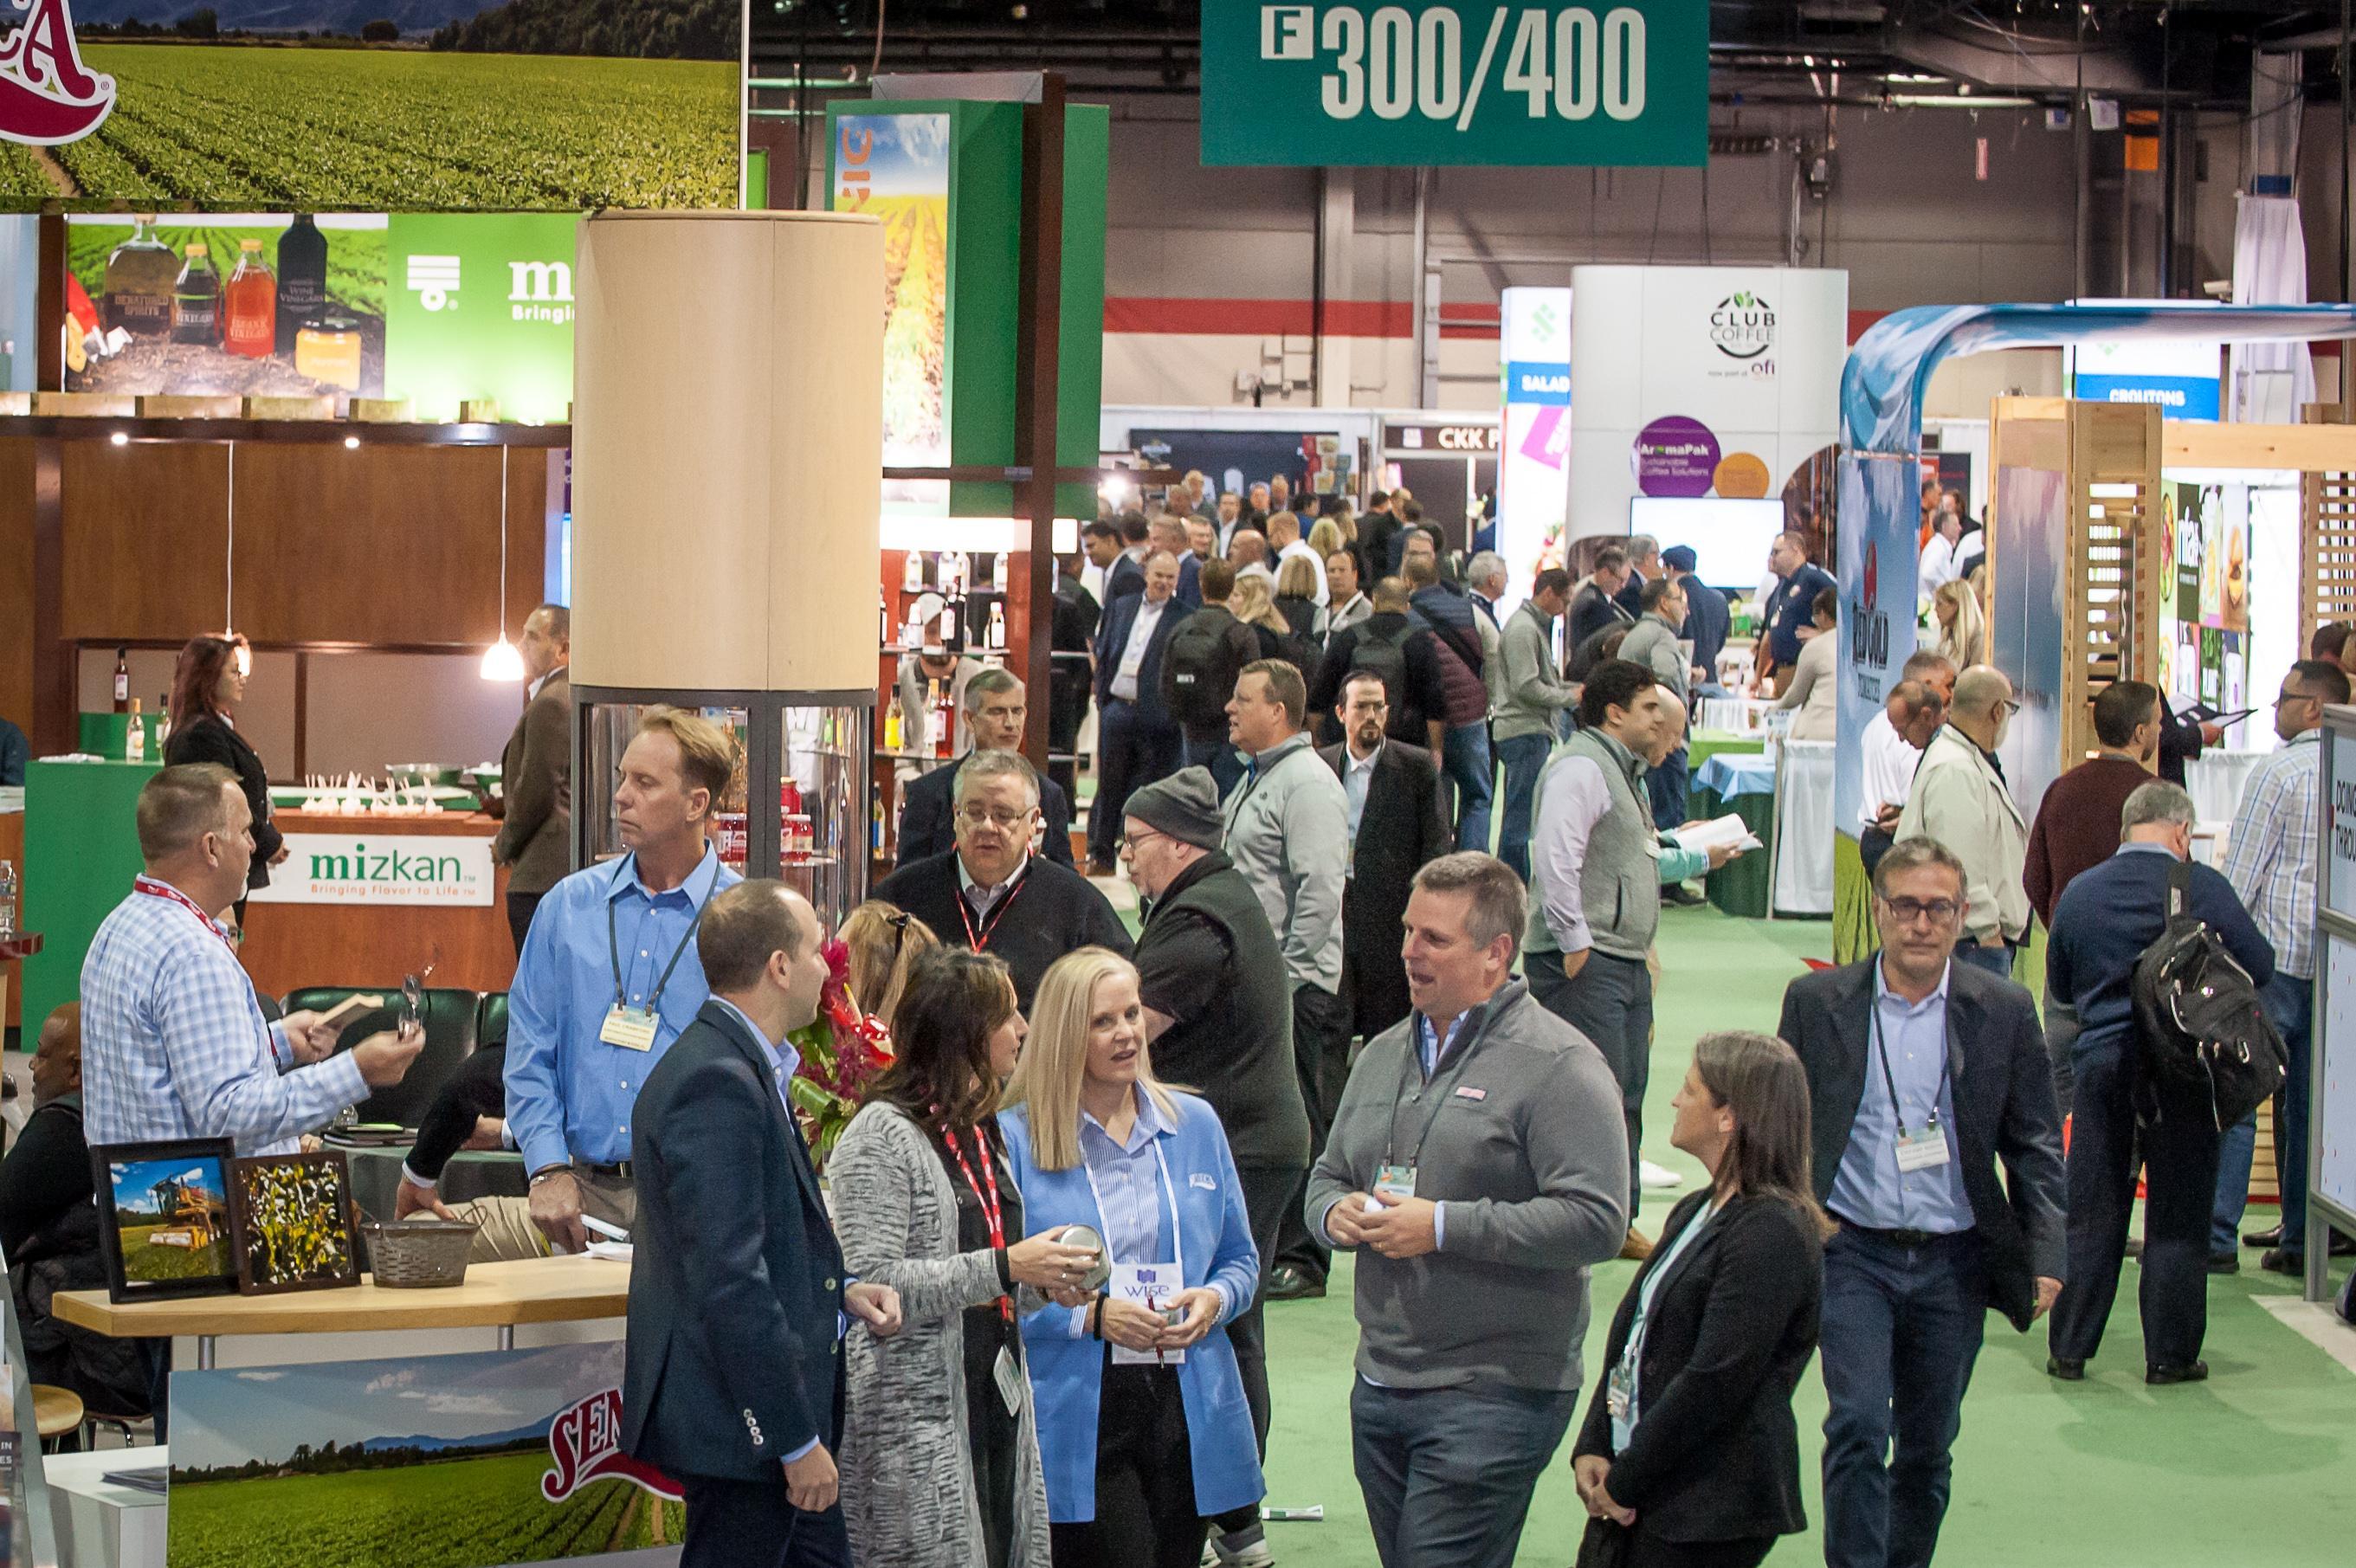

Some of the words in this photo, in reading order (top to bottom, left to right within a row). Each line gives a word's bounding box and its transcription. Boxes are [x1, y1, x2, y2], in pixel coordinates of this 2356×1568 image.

[1274, 10, 1301, 55] F
[1321, 7, 1647, 132] 300/400
[1710, 312, 1775, 326] CLUB
[1710, 328, 1775, 341] COFFEE
[1521, 374, 1570, 392] SALAD
[2108, 388, 2186, 407] CROUTONS
[1438, 427, 1484, 449] CKK
[309, 842, 461, 882] mizkan
[311, 883, 365, 896] Bringing
[372, 885, 412, 895] Flavor
[417, 885, 430, 895] to
[436, 885, 459, 895] Life
